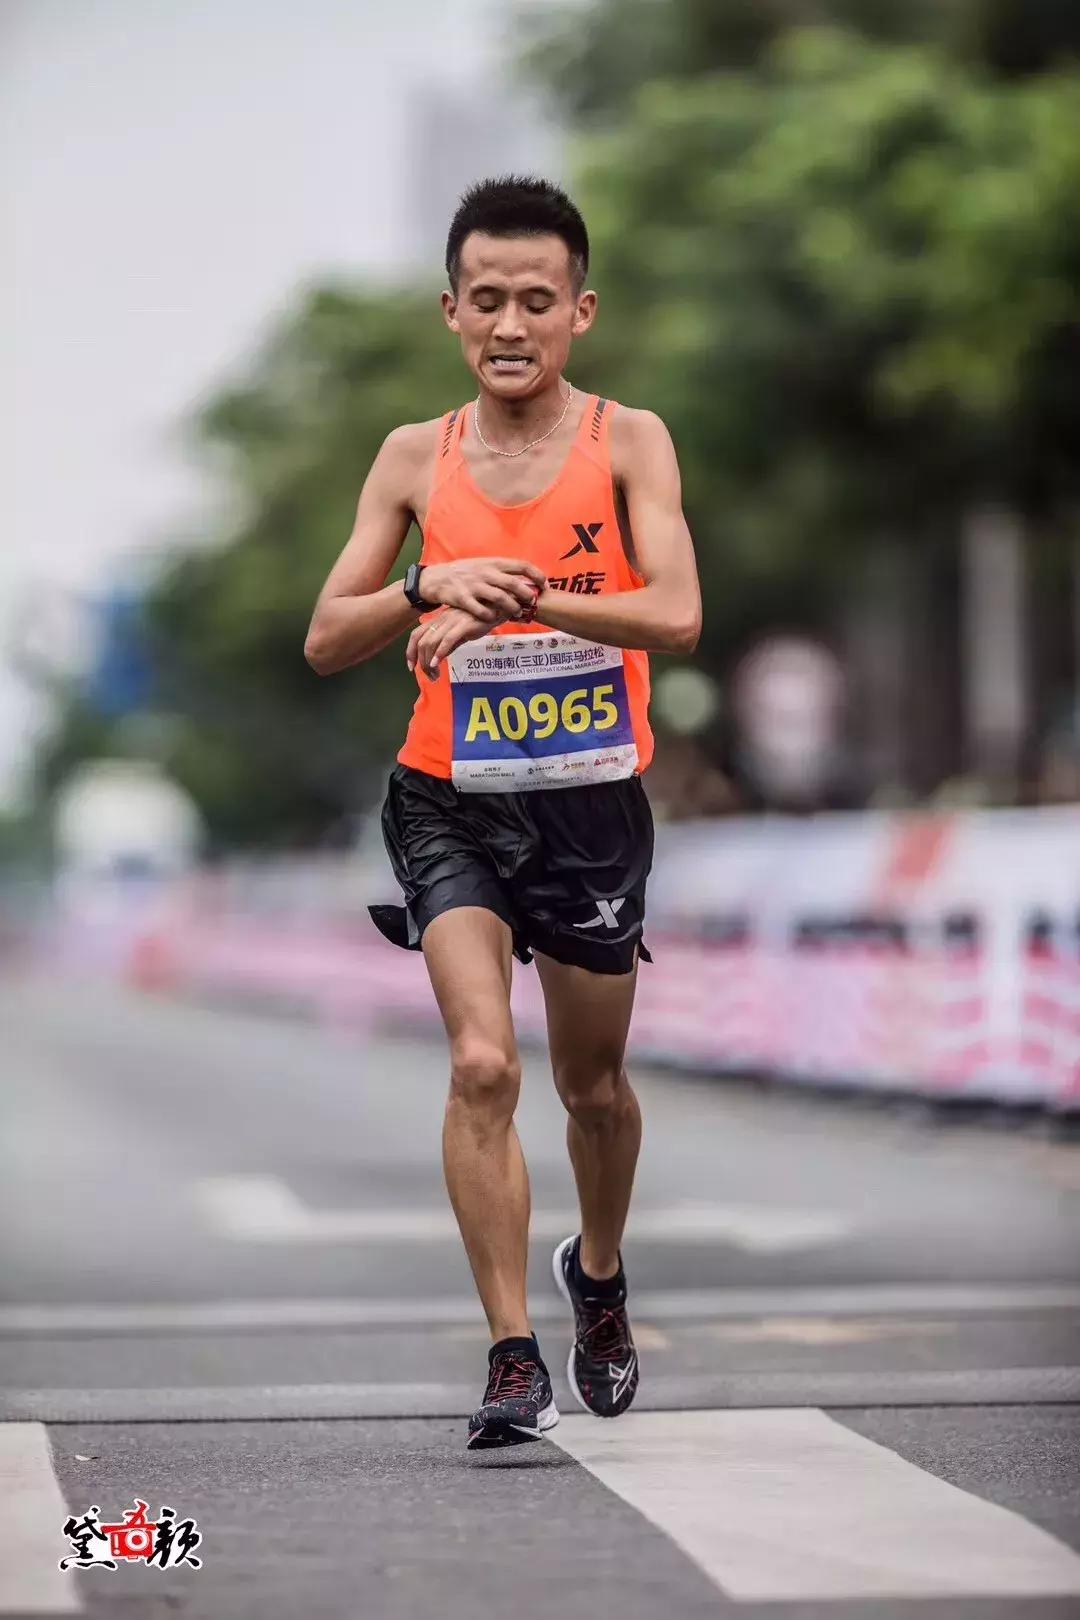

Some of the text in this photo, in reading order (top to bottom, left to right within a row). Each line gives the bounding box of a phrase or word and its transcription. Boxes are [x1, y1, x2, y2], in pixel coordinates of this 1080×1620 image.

[466, 646, 605, 670] 2019海南(三亚)国际马拉松
[527, 665, 574, 674] INTERNATIONAL
[575, 659, 606, 669] MARATHON
[464, 684, 618, 742] A0965
